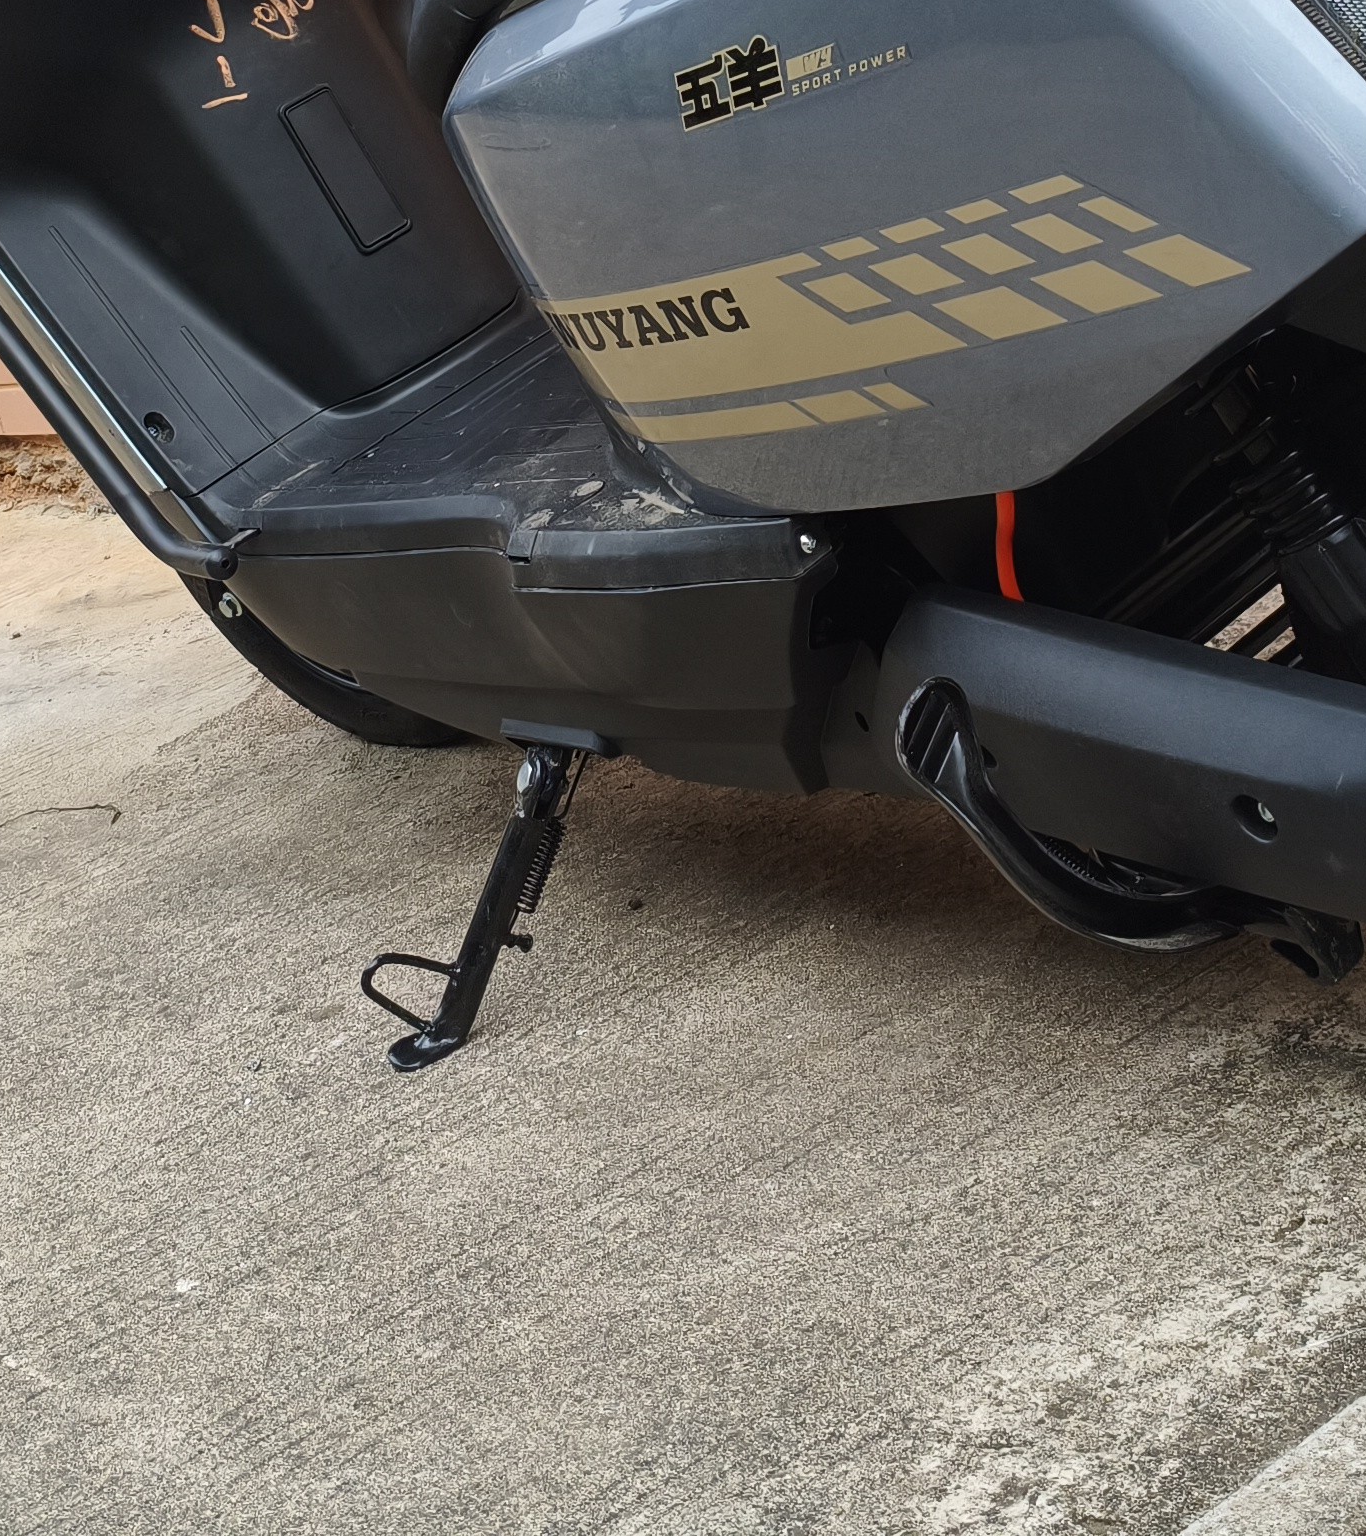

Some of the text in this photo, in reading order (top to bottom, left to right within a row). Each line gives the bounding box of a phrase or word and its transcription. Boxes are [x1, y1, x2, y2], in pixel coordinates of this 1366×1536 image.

[674, 35, 784, 132] 五羊
[791, 45, 906, 97] SPORT POWER
